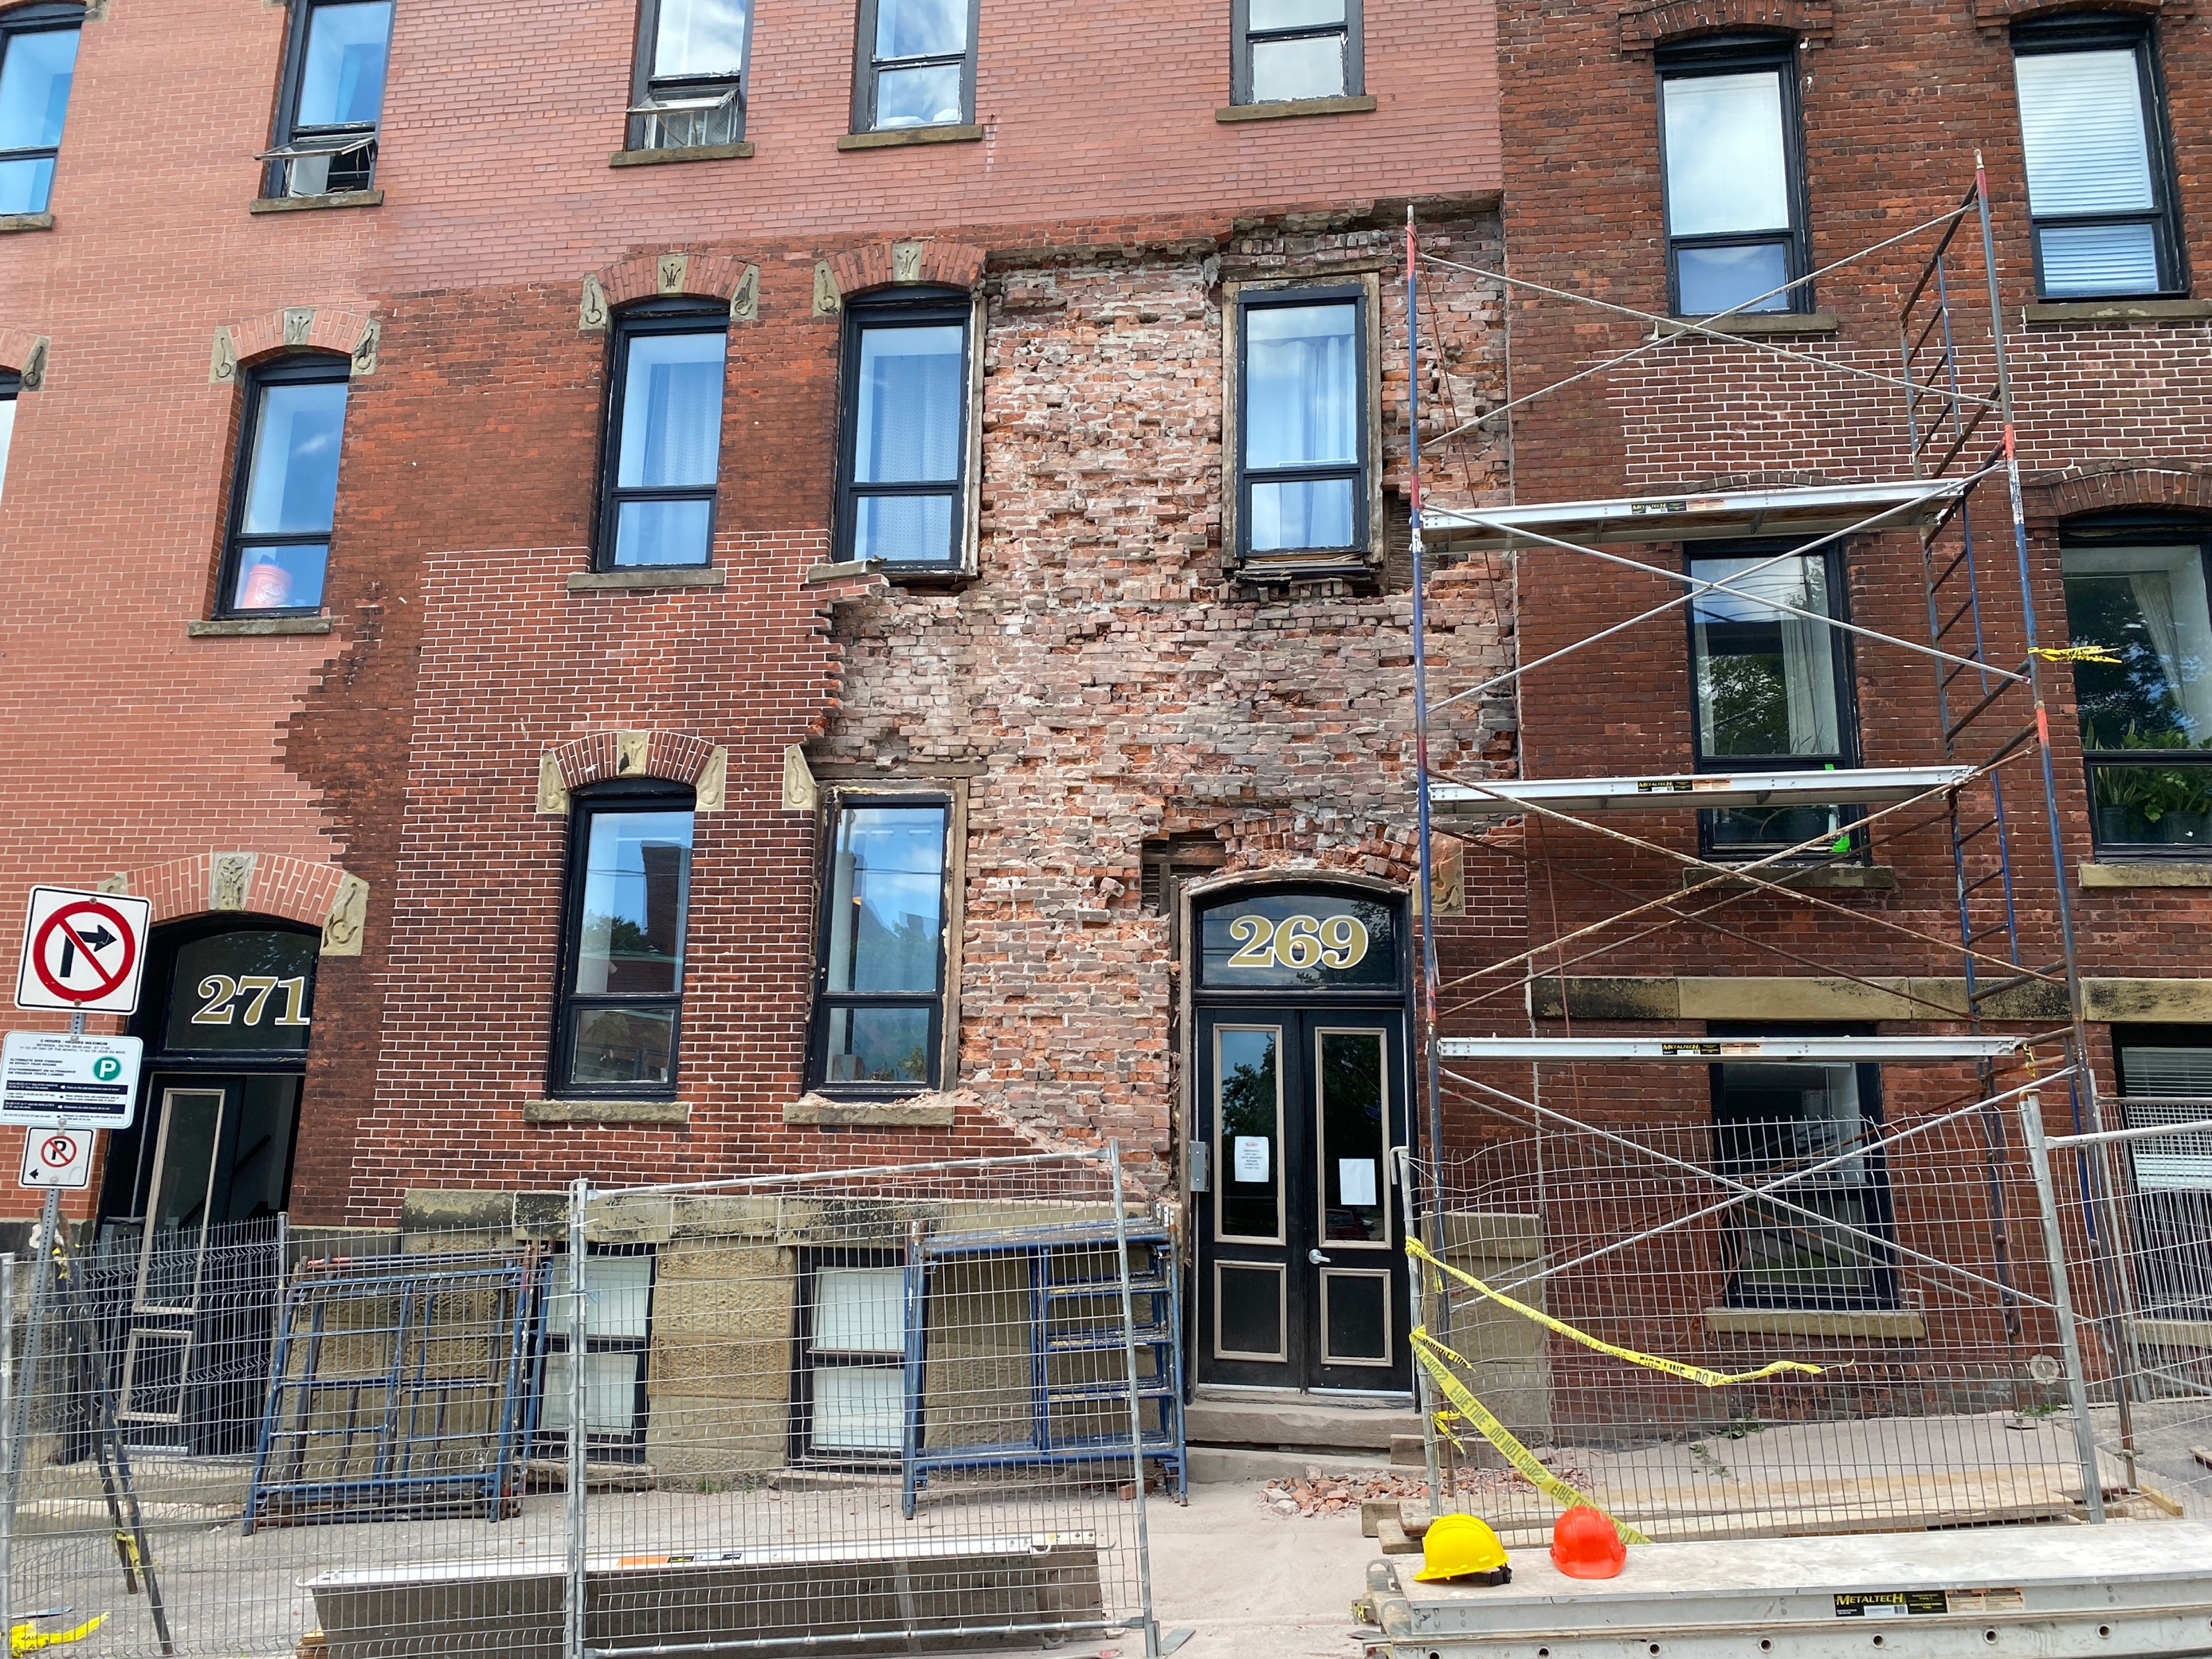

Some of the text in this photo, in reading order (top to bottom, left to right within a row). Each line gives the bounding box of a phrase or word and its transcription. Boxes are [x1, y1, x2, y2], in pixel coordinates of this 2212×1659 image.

[1228, 915, 1369, 969] 269
[190, 974, 310, 1026] 271
[100, 1060, 116, 1078] P
[1695, 1371, 1709, 1384] DO
[1836, 1593, 1904, 1606] METALTECH
